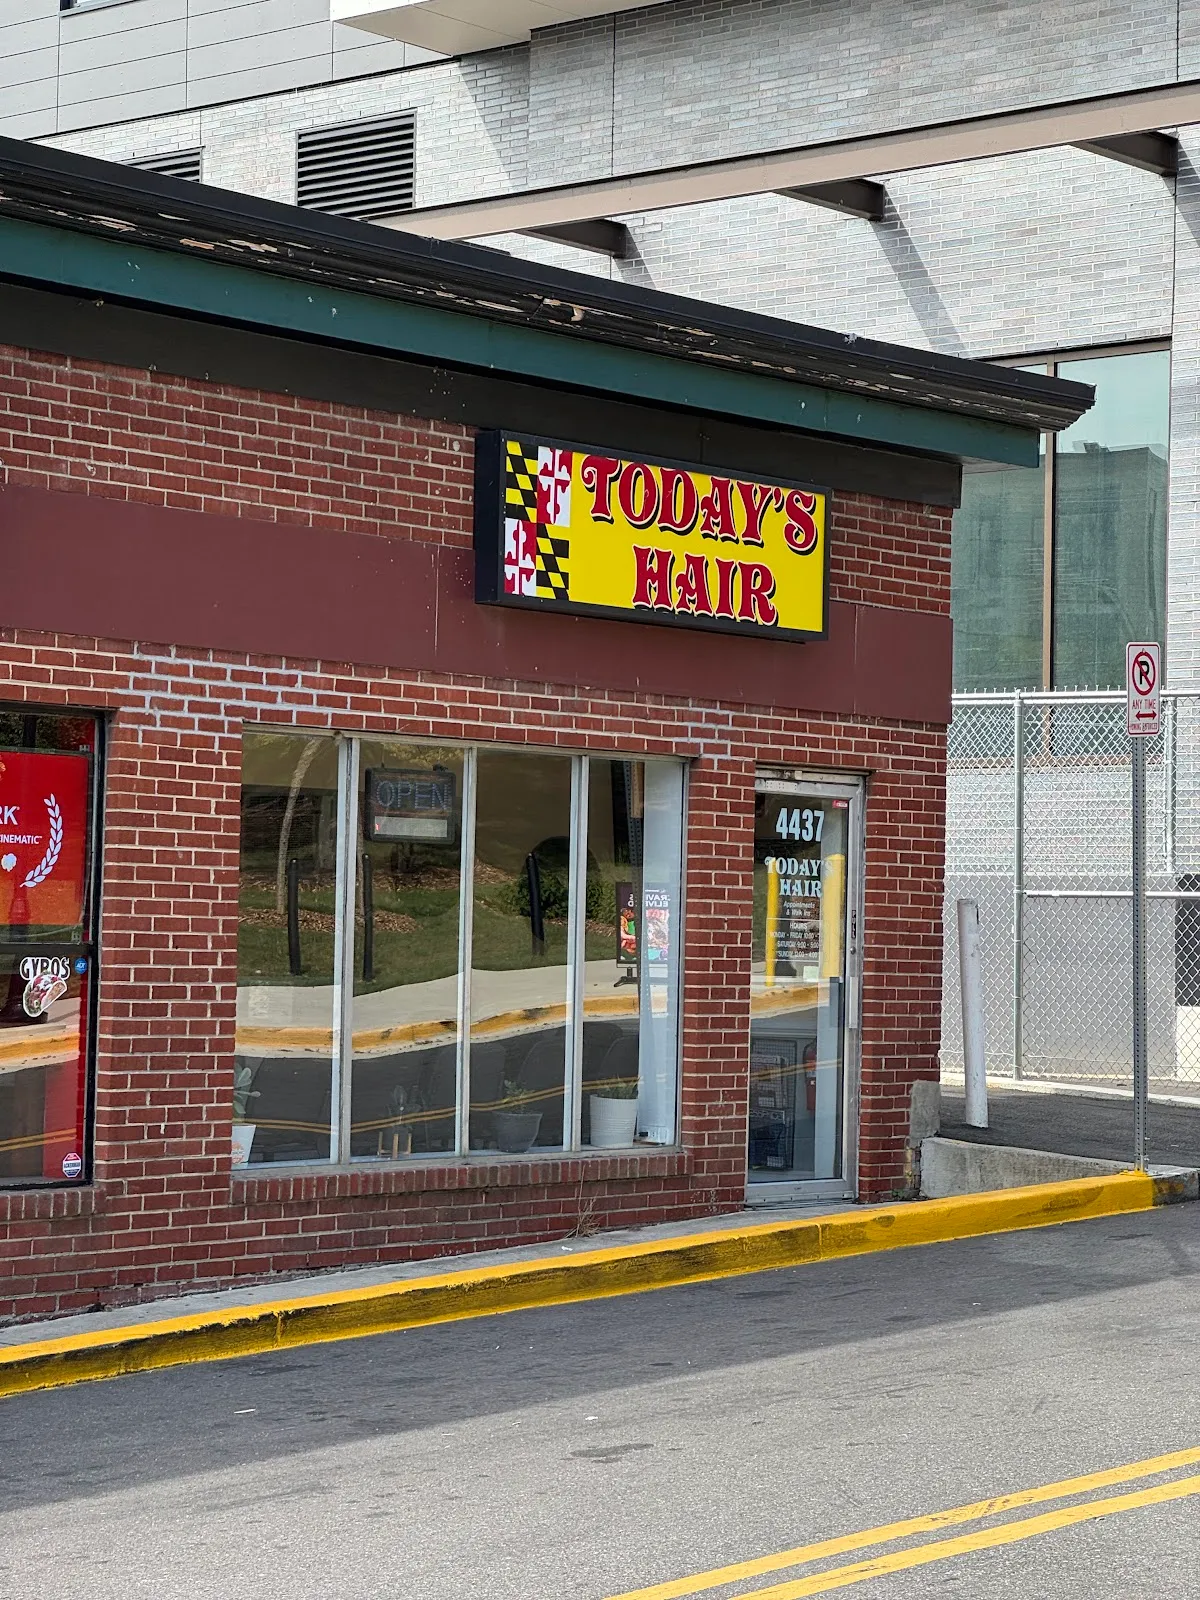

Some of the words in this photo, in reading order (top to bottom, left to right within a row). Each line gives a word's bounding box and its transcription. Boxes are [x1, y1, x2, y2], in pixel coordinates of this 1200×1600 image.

[581, 454, 818, 556] TODAY'S
[632, 545, 779, 627] HAIR
[1132, 699, 1142, 709] ANY
[1144, 699, 1156, 709] TIME
[376, 781, 448, 810] OPEN
[775, 807, 825, 842] 4437
[764, 856, 834, 877] TODAY'S
[779, 878, 823, 898] HAIR
[783, 901, 816, 909] Appointments
[777, 940, 796, 948] SATURDAY
[20, 956, 71, 980] GYROS
